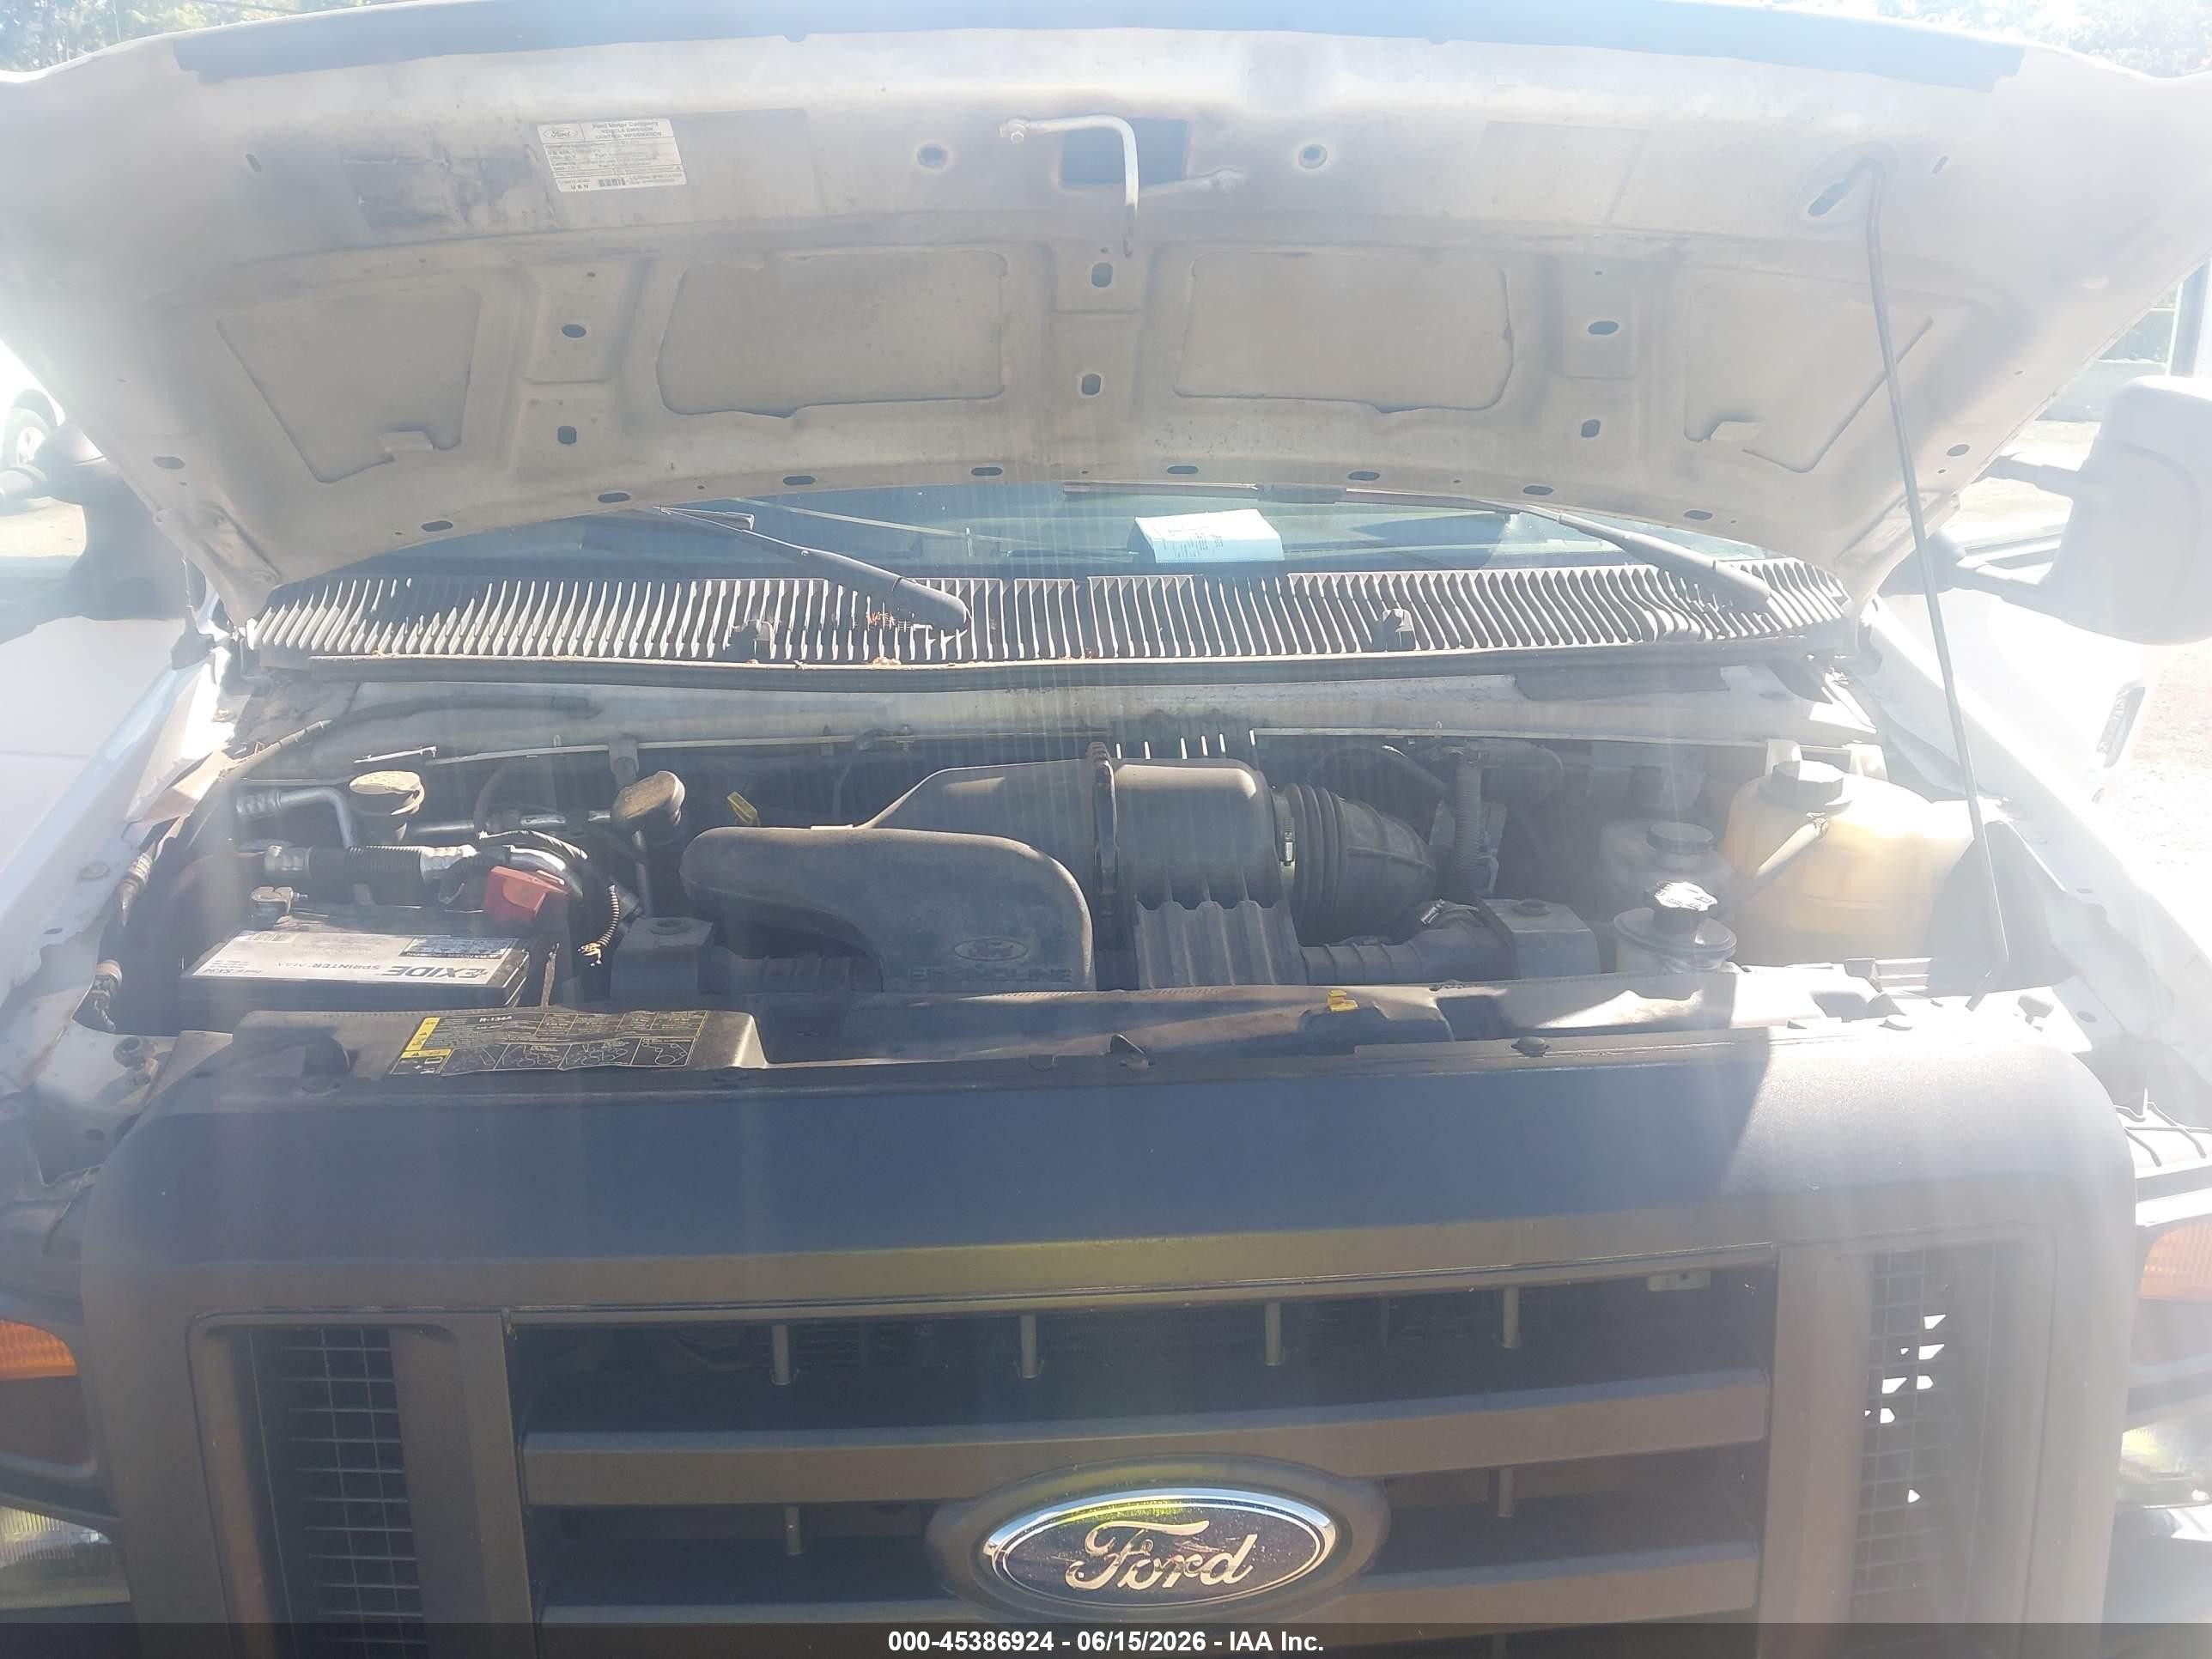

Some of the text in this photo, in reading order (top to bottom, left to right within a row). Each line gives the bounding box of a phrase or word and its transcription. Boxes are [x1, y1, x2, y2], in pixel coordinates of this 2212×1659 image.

[628, 120, 659, 129] Company
[380, 965, 488, 979] EXIDE
[1066, 1519, 1258, 1591] Ford
